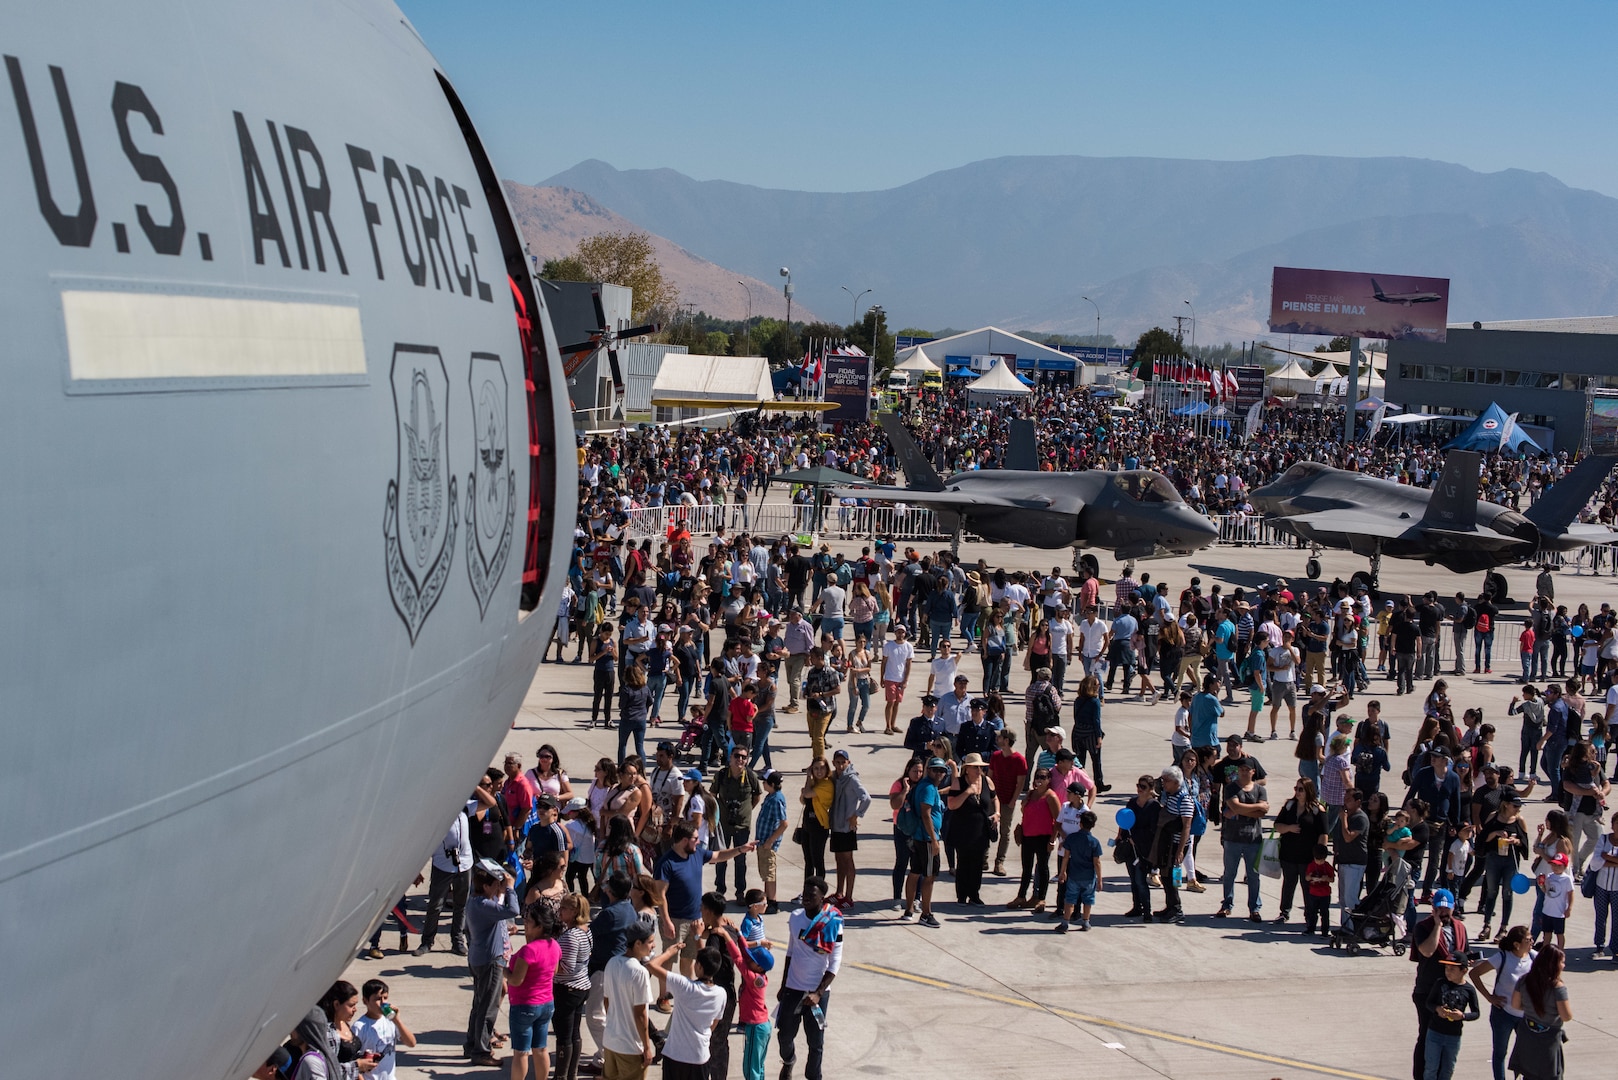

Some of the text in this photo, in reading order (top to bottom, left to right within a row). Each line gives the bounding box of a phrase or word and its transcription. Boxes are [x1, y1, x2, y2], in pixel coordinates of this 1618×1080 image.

[3, 54, 494, 304] U.S. AIR FORCE
[1305, 293, 1328, 302] PIENSE
[1281, 300, 1367, 316] PIENSE EN MAX
[1445, 484, 1457, 498] LF
